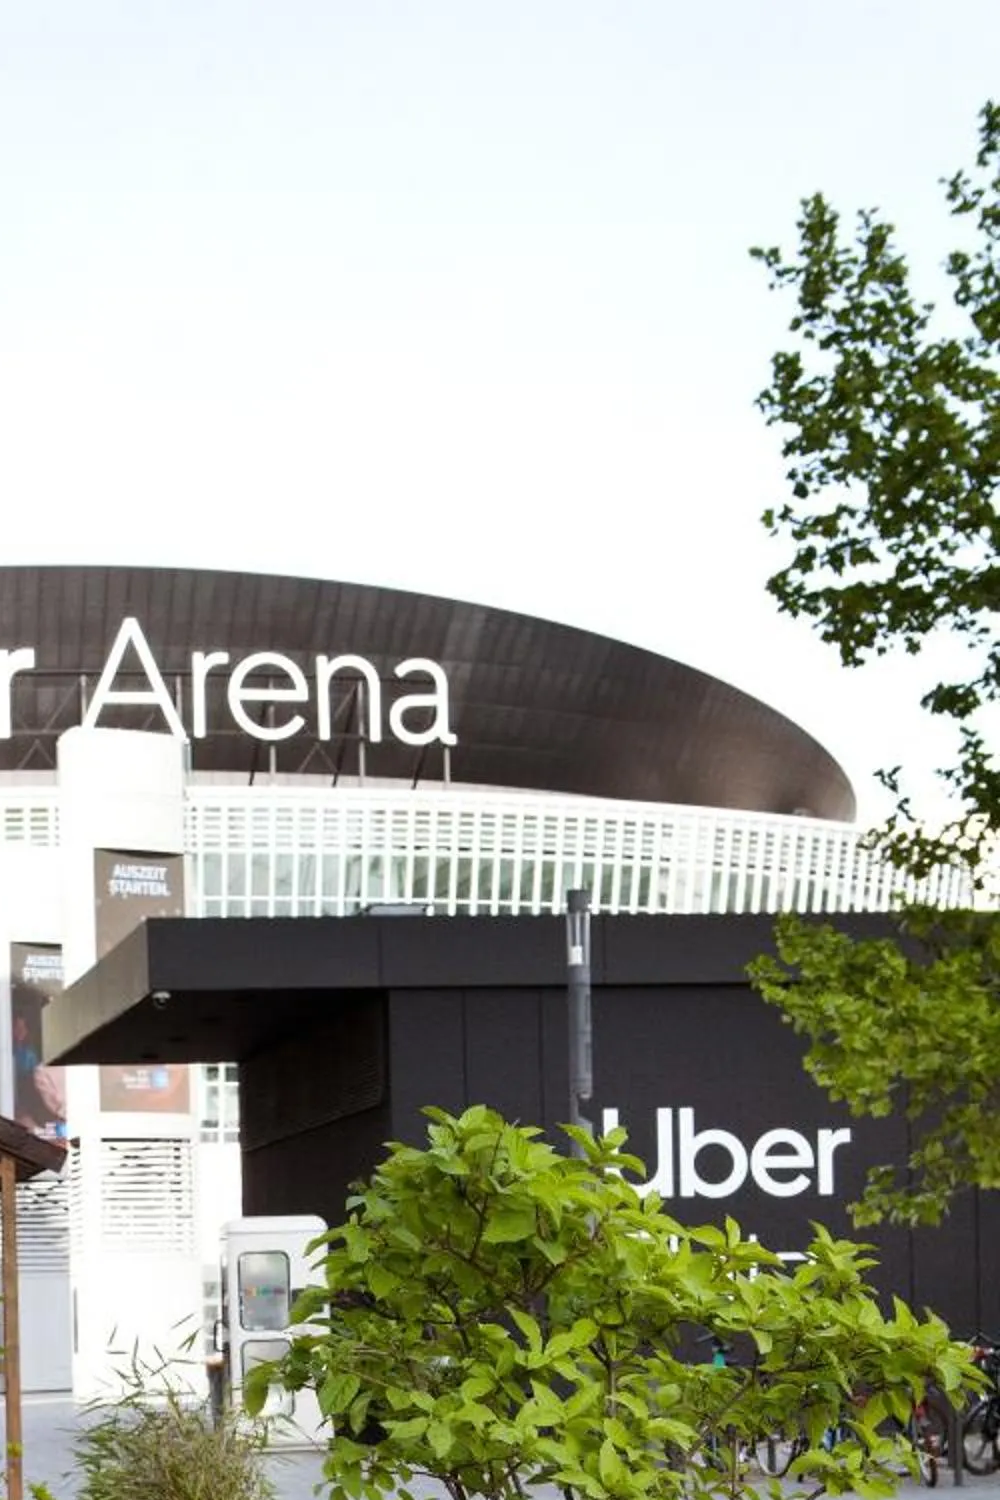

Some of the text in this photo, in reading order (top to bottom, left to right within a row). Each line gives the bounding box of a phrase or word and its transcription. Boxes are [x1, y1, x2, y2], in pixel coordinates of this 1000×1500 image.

[81, 616, 458, 745] Arena
[112, 863, 168, 881] AUSZEIT
[603, 1107, 852, 1199] Uber
